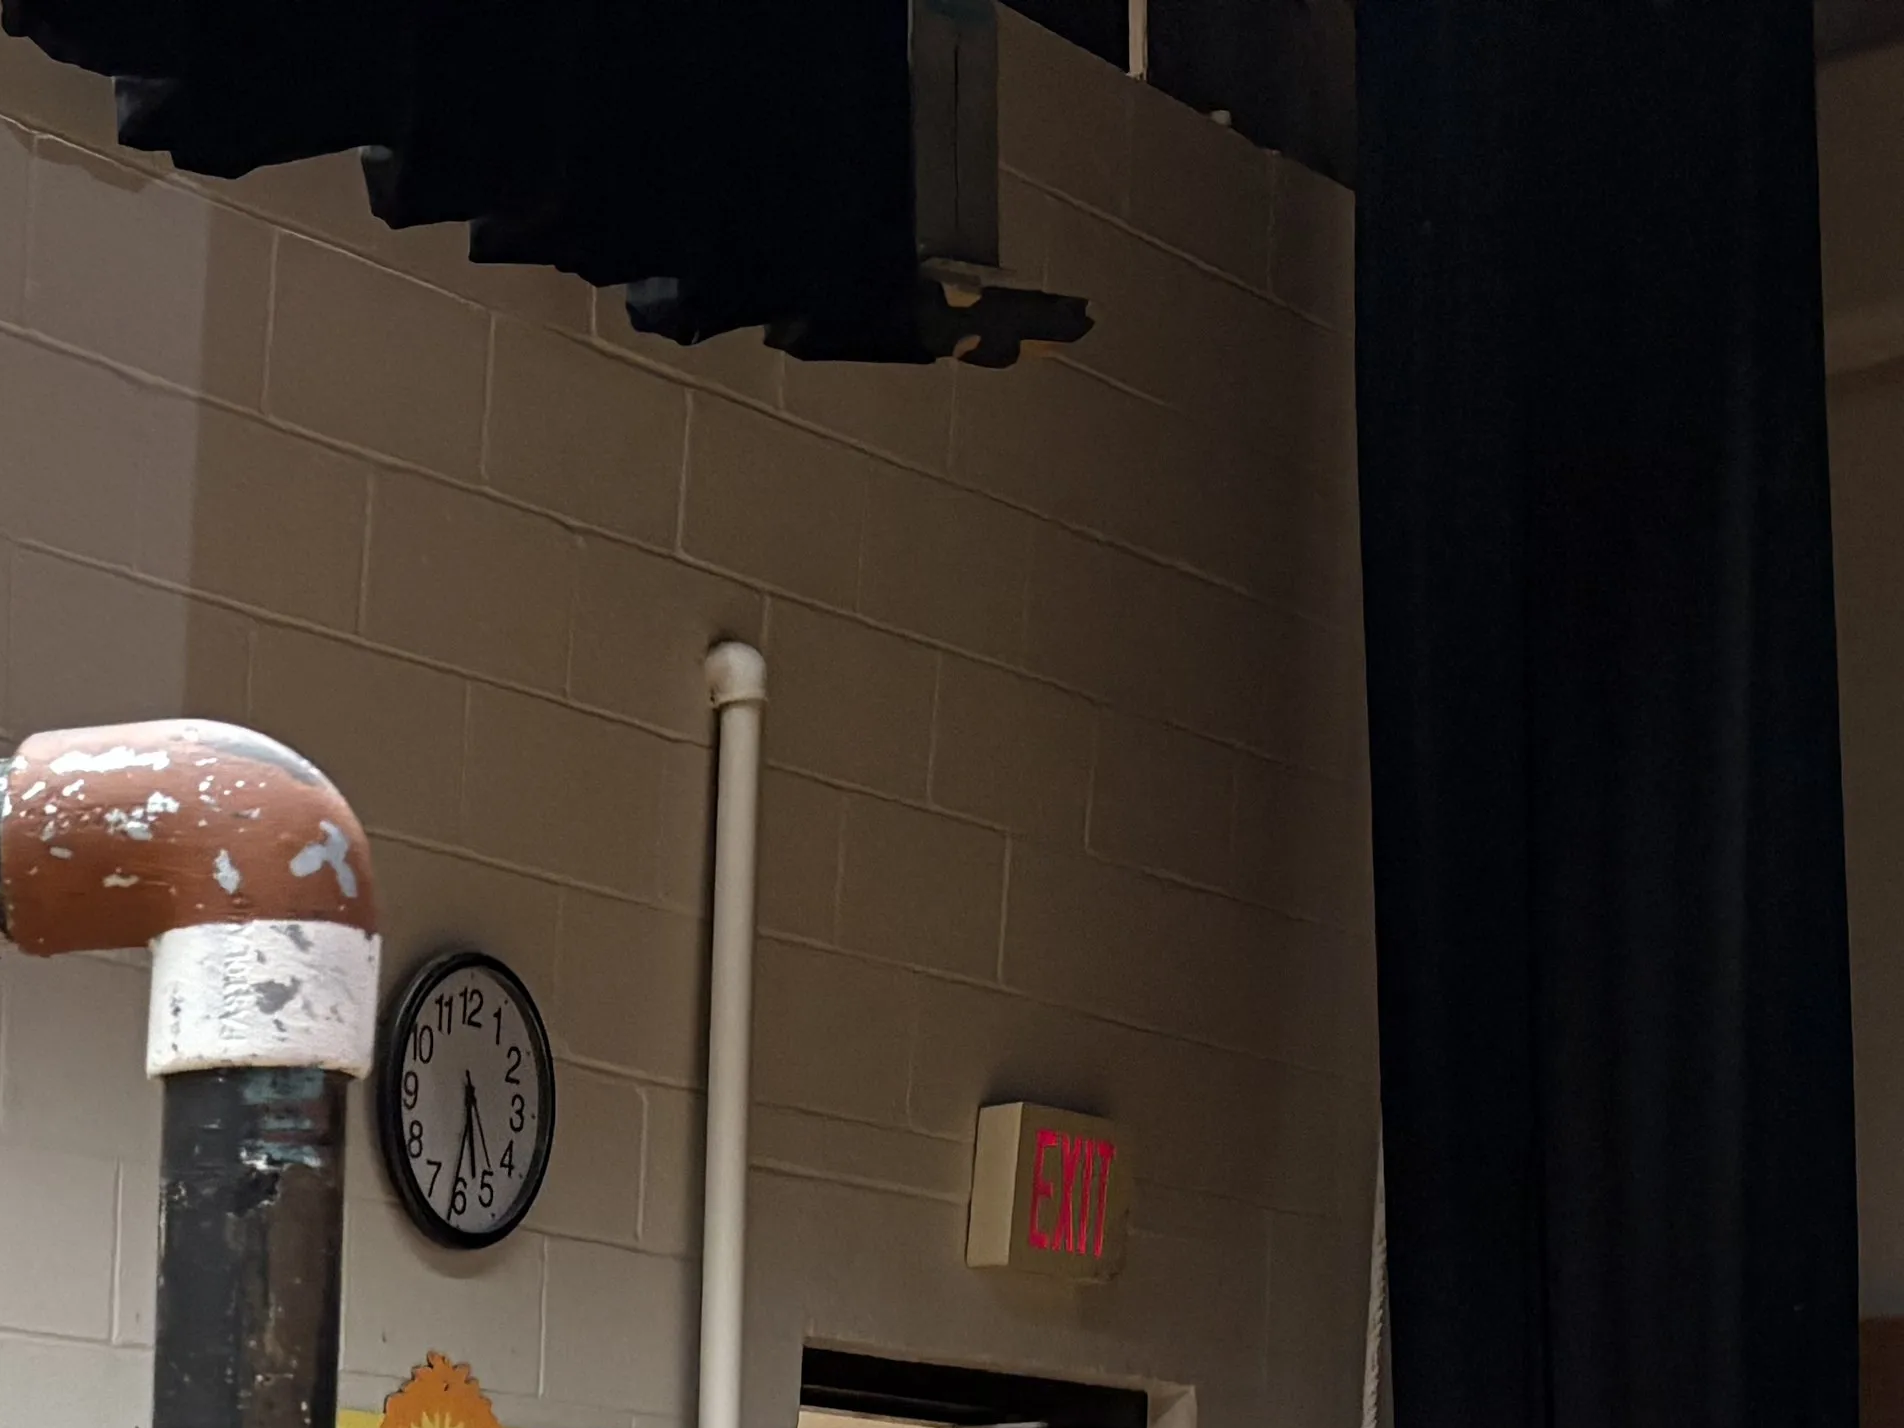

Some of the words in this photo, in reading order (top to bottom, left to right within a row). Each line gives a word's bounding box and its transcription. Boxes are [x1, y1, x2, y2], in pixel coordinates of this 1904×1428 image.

[435, 993, 454, 1034] 11
[459, 987, 483, 1027] 12
[493, 1007, 503, 1045] 1
[413, 1024, 433, 1064] 10
[505, 1047, 521, 1085] 2
[403, 1071, 418, 1110] 9
[510, 1094, 524, 1133] 3
[408, 1120, 423, 1158] 8
[500, 1140, 514, 1177] 4
[426, 1160, 441, 1198] 7
[451, 1177, 467, 1215] 6
[478, 1171, 493, 1208] 5
[1028, 1128, 1116, 1259] EXIT
